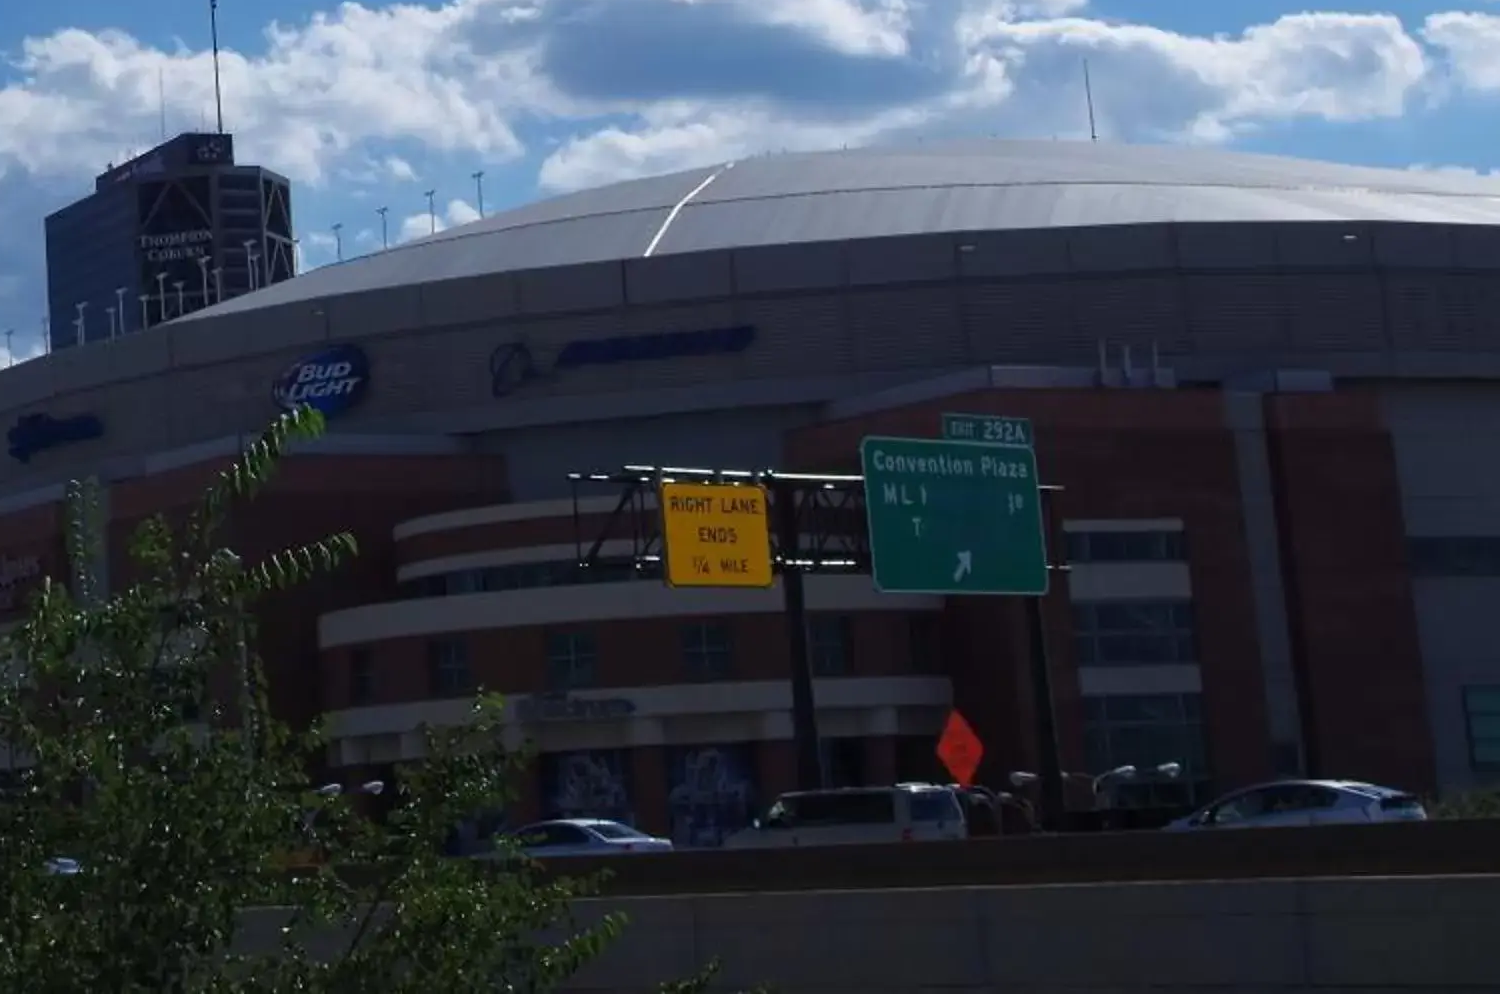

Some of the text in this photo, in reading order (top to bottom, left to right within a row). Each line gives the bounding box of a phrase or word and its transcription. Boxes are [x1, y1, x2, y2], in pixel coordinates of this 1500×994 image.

[296, 360, 352, 383] BUD
[285, 376, 363, 398] LIGHT
[983, 420, 1026, 442] 292A
[873, 449, 1029, 478] Convention Plaza
[670, 493, 759, 515] RIGHT LANE
[698, 526, 738, 544] ENDS
[720, 556, 750, 574] MILE
